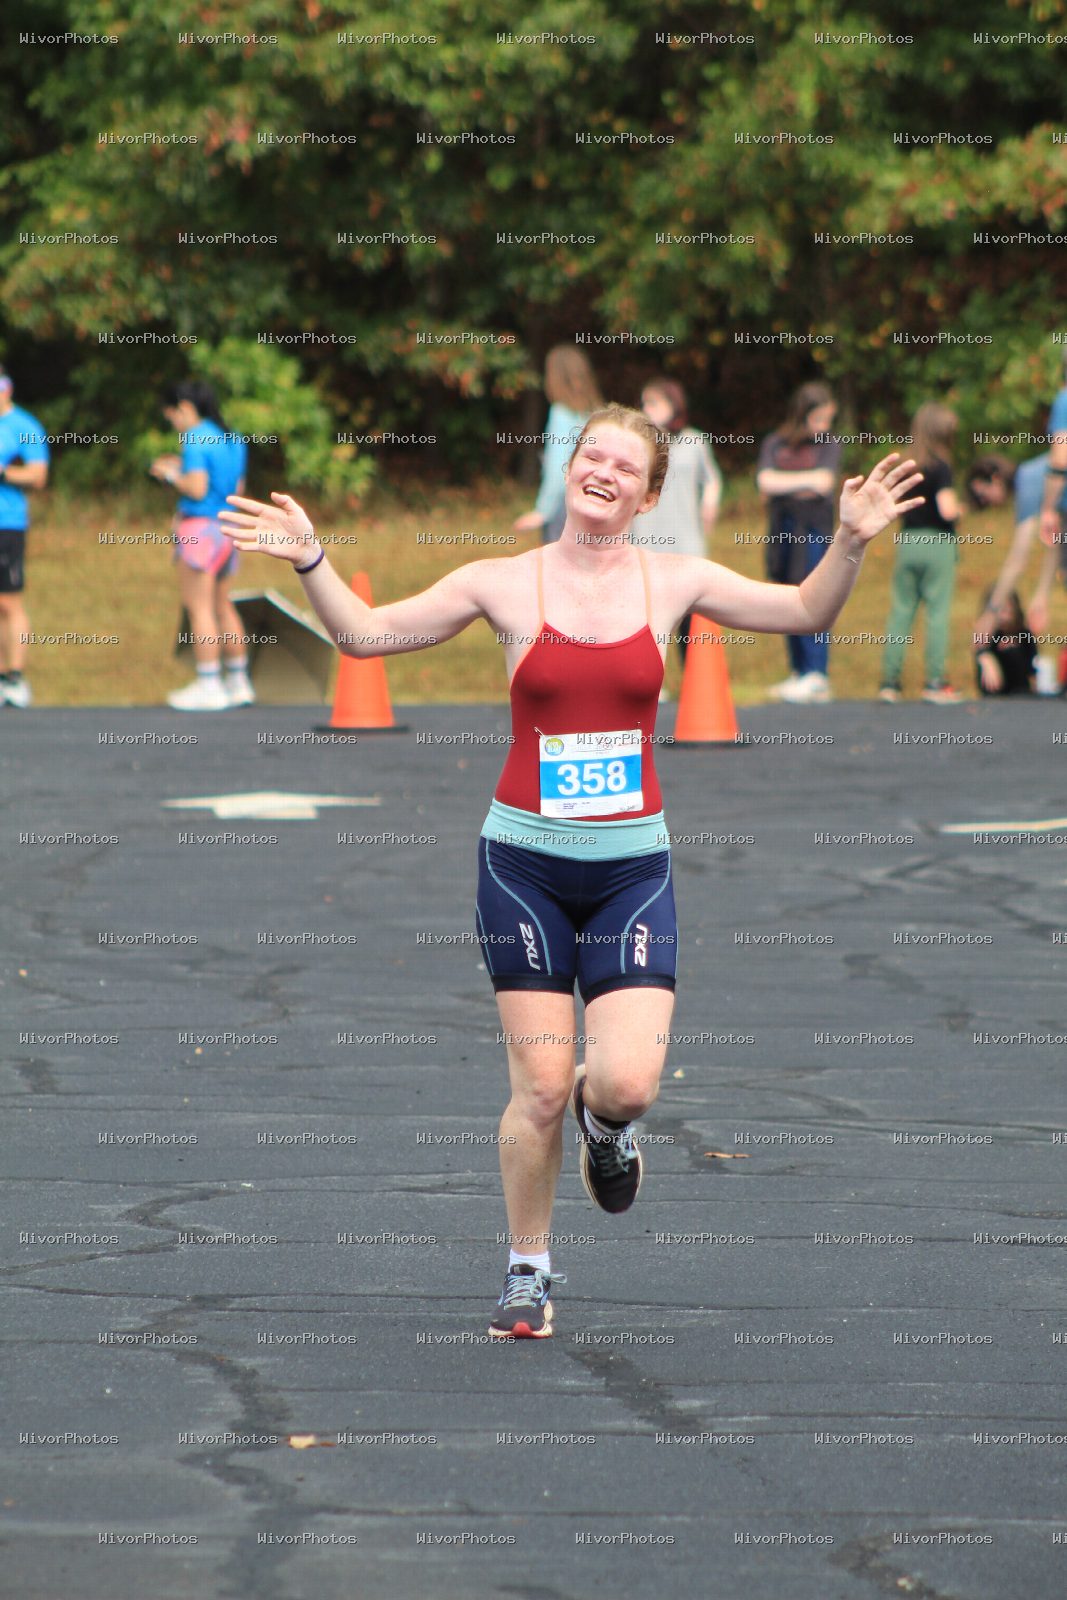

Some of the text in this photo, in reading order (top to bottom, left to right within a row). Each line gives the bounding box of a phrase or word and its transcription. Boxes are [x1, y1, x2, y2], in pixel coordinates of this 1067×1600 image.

[557, 760, 627, 796] 358
[519, 922, 541, 971] 2XU
[634, 923, 648, 967] 2XU
